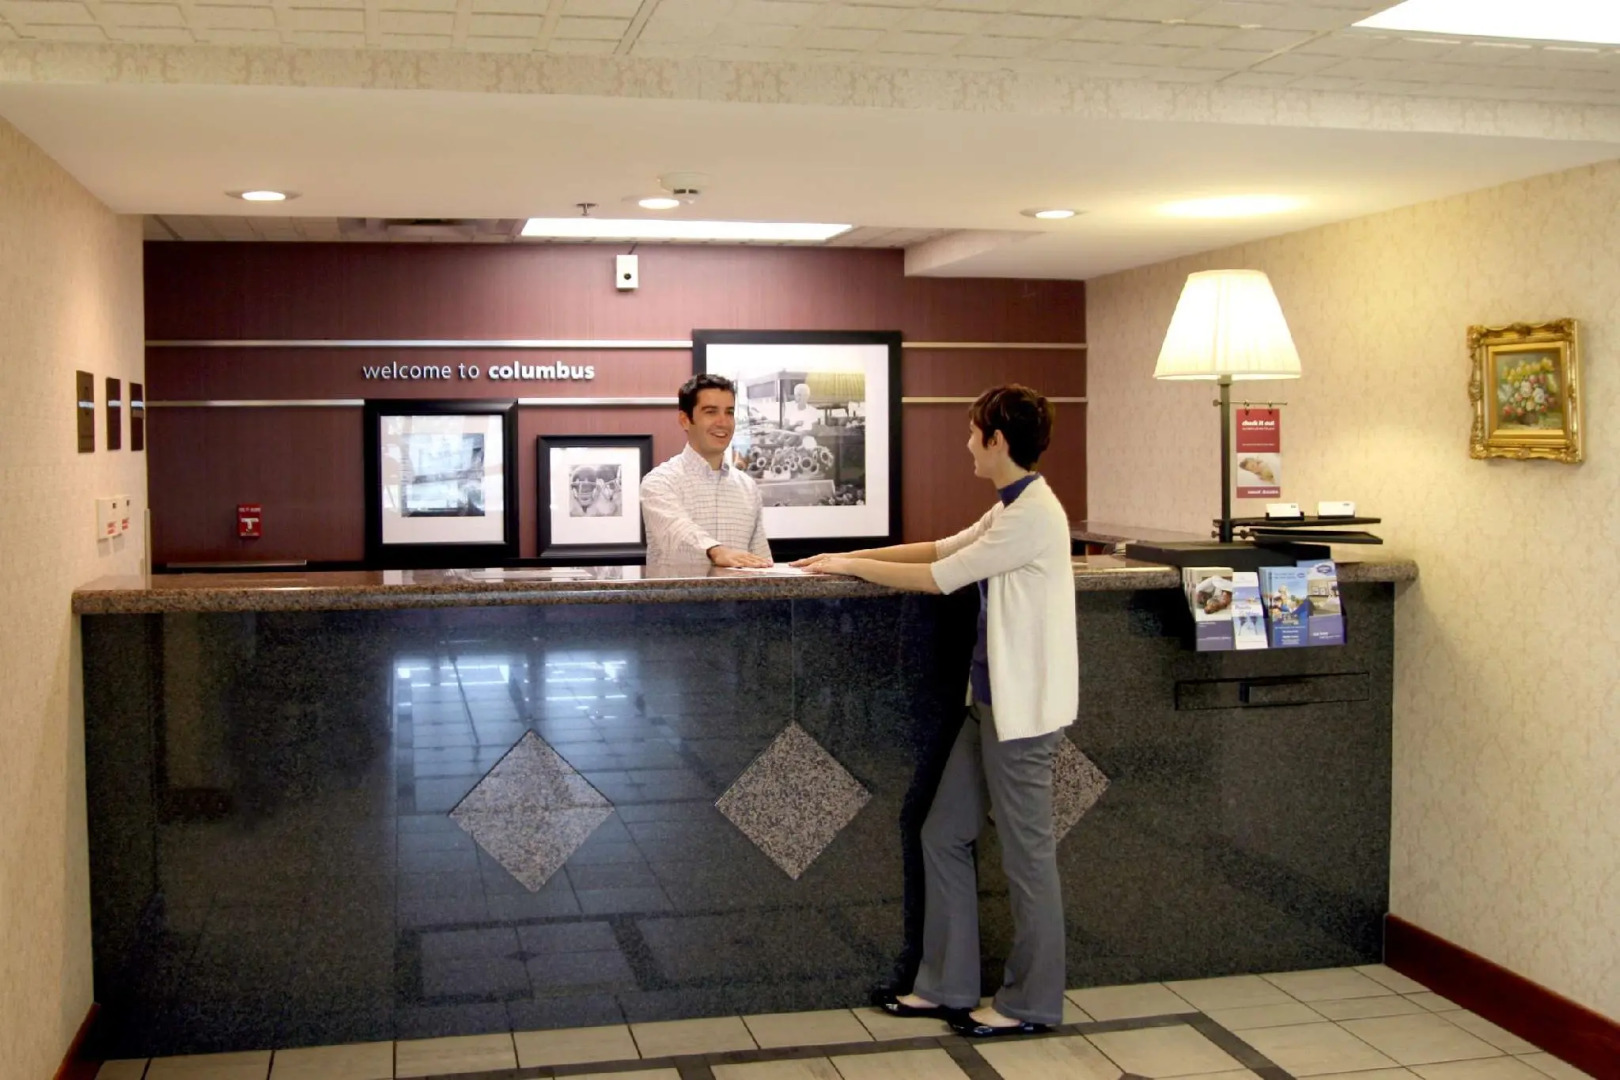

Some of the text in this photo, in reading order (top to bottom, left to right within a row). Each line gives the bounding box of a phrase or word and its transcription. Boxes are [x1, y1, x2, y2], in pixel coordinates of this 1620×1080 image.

[362, 361, 595, 380] welcome to columbus
